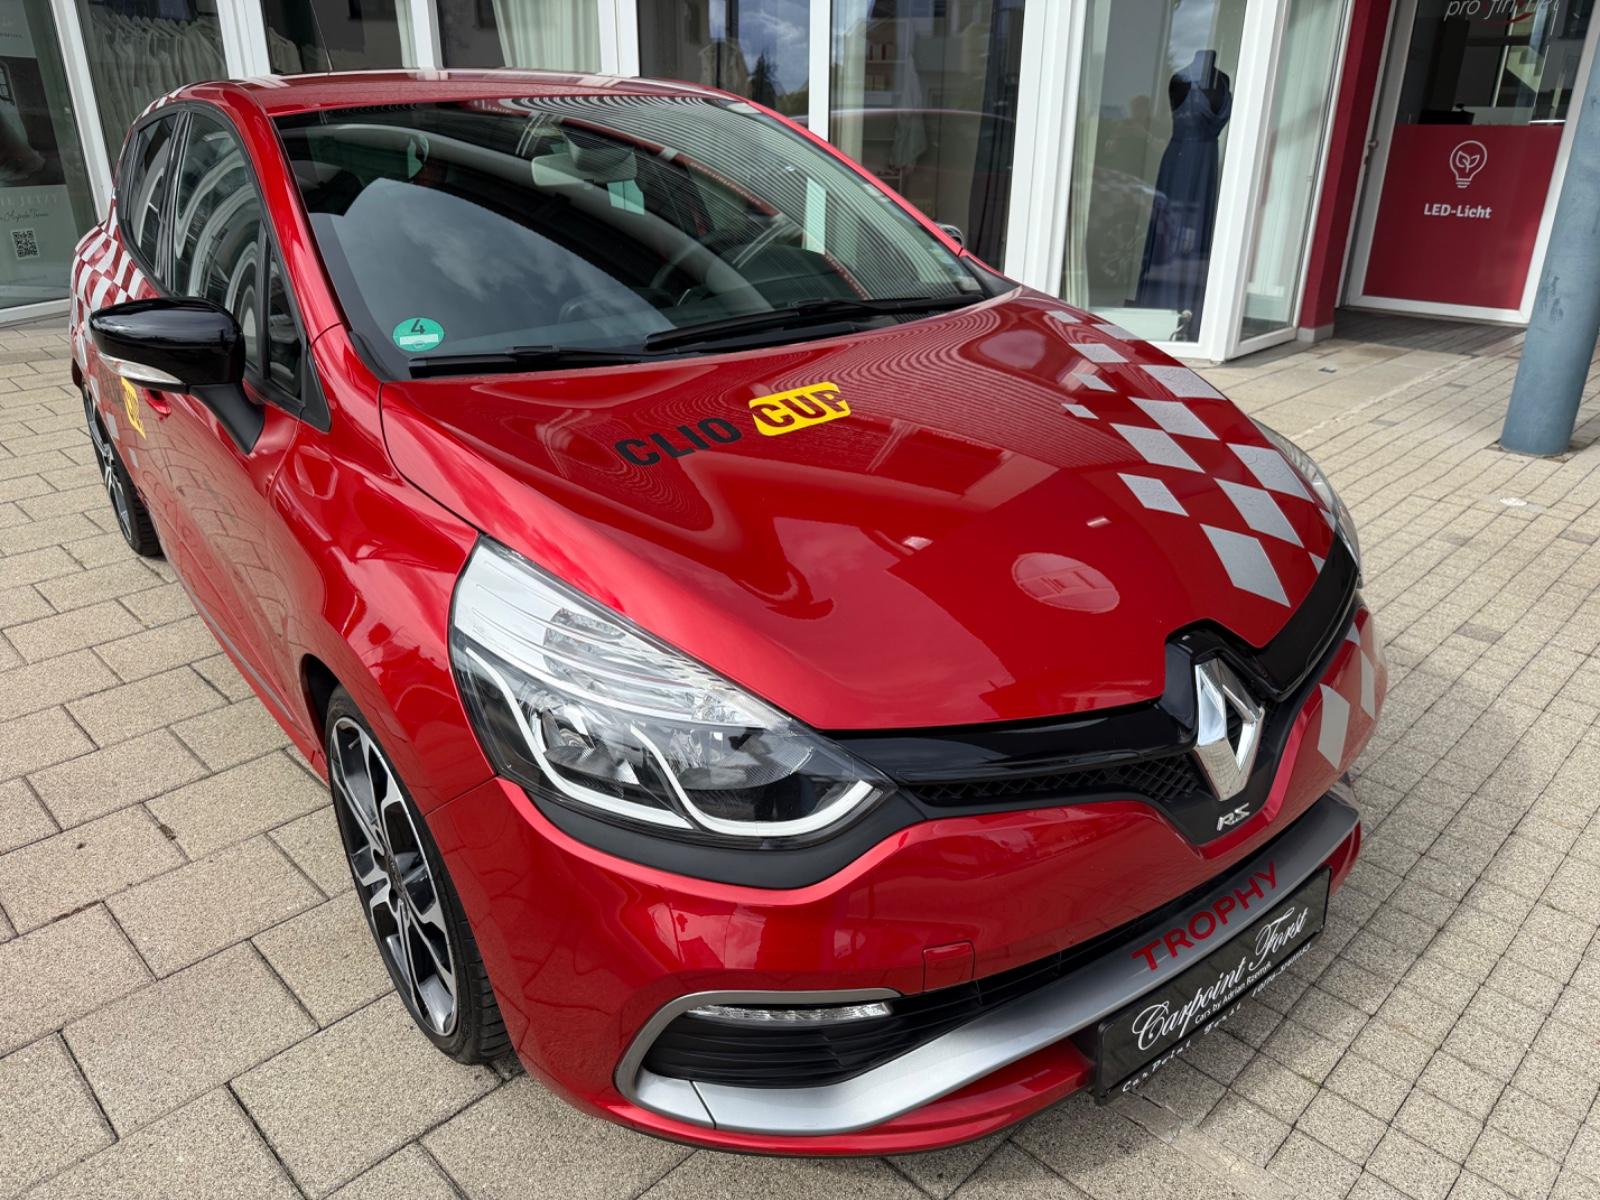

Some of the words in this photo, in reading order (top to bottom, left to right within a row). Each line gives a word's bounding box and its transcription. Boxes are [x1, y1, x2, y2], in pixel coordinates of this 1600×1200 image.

[1423, 203, 1492, 219] LED-Licht
[411, 318, 426, 335] 4
[614, 417, 742, 466] CLIO
[750, 389, 845, 428] CUP
[1216, 802, 1250, 831] RS
[1131, 861, 1279, 972] TROPHY
[1131, 956, 1246, 1051] Carpoint
[1195, 1008, 1211, 1024] Cars
